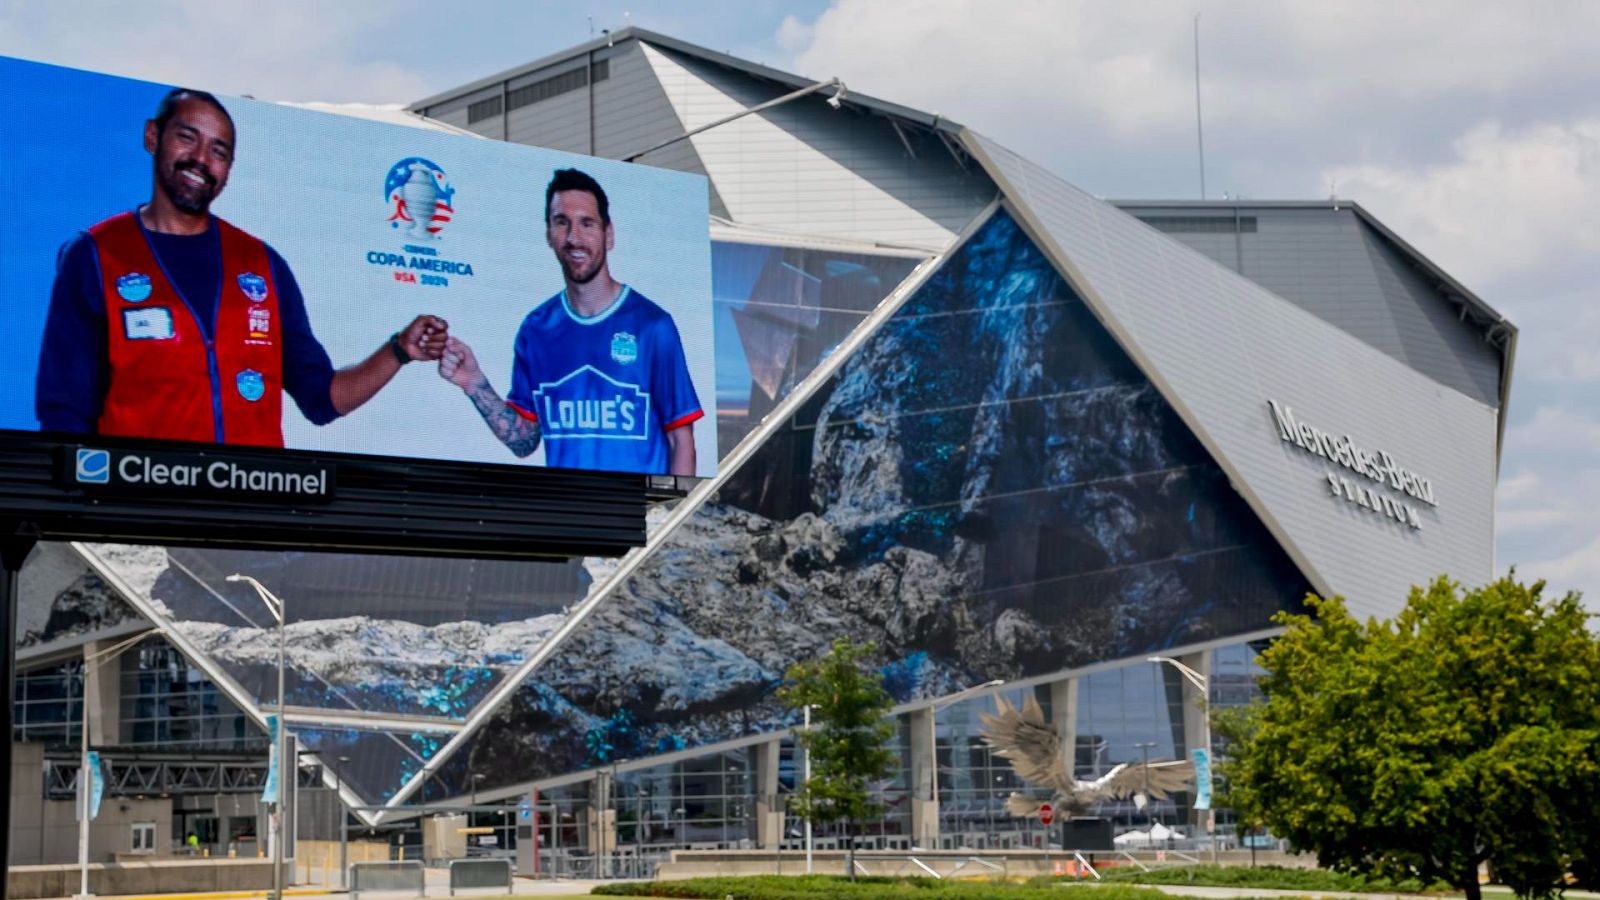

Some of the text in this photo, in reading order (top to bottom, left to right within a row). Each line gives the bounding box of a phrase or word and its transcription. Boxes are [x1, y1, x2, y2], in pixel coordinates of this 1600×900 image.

[367, 251, 474, 276] COPA AMERICA
[394, 271, 417, 283] USA
[544, 395, 635, 431] LOWE'S
[1267, 400, 1439, 507] Mercedes-Benz
[118, 455, 326, 495] Clear Channel
[1325, 471, 1422, 529] STADIUM
